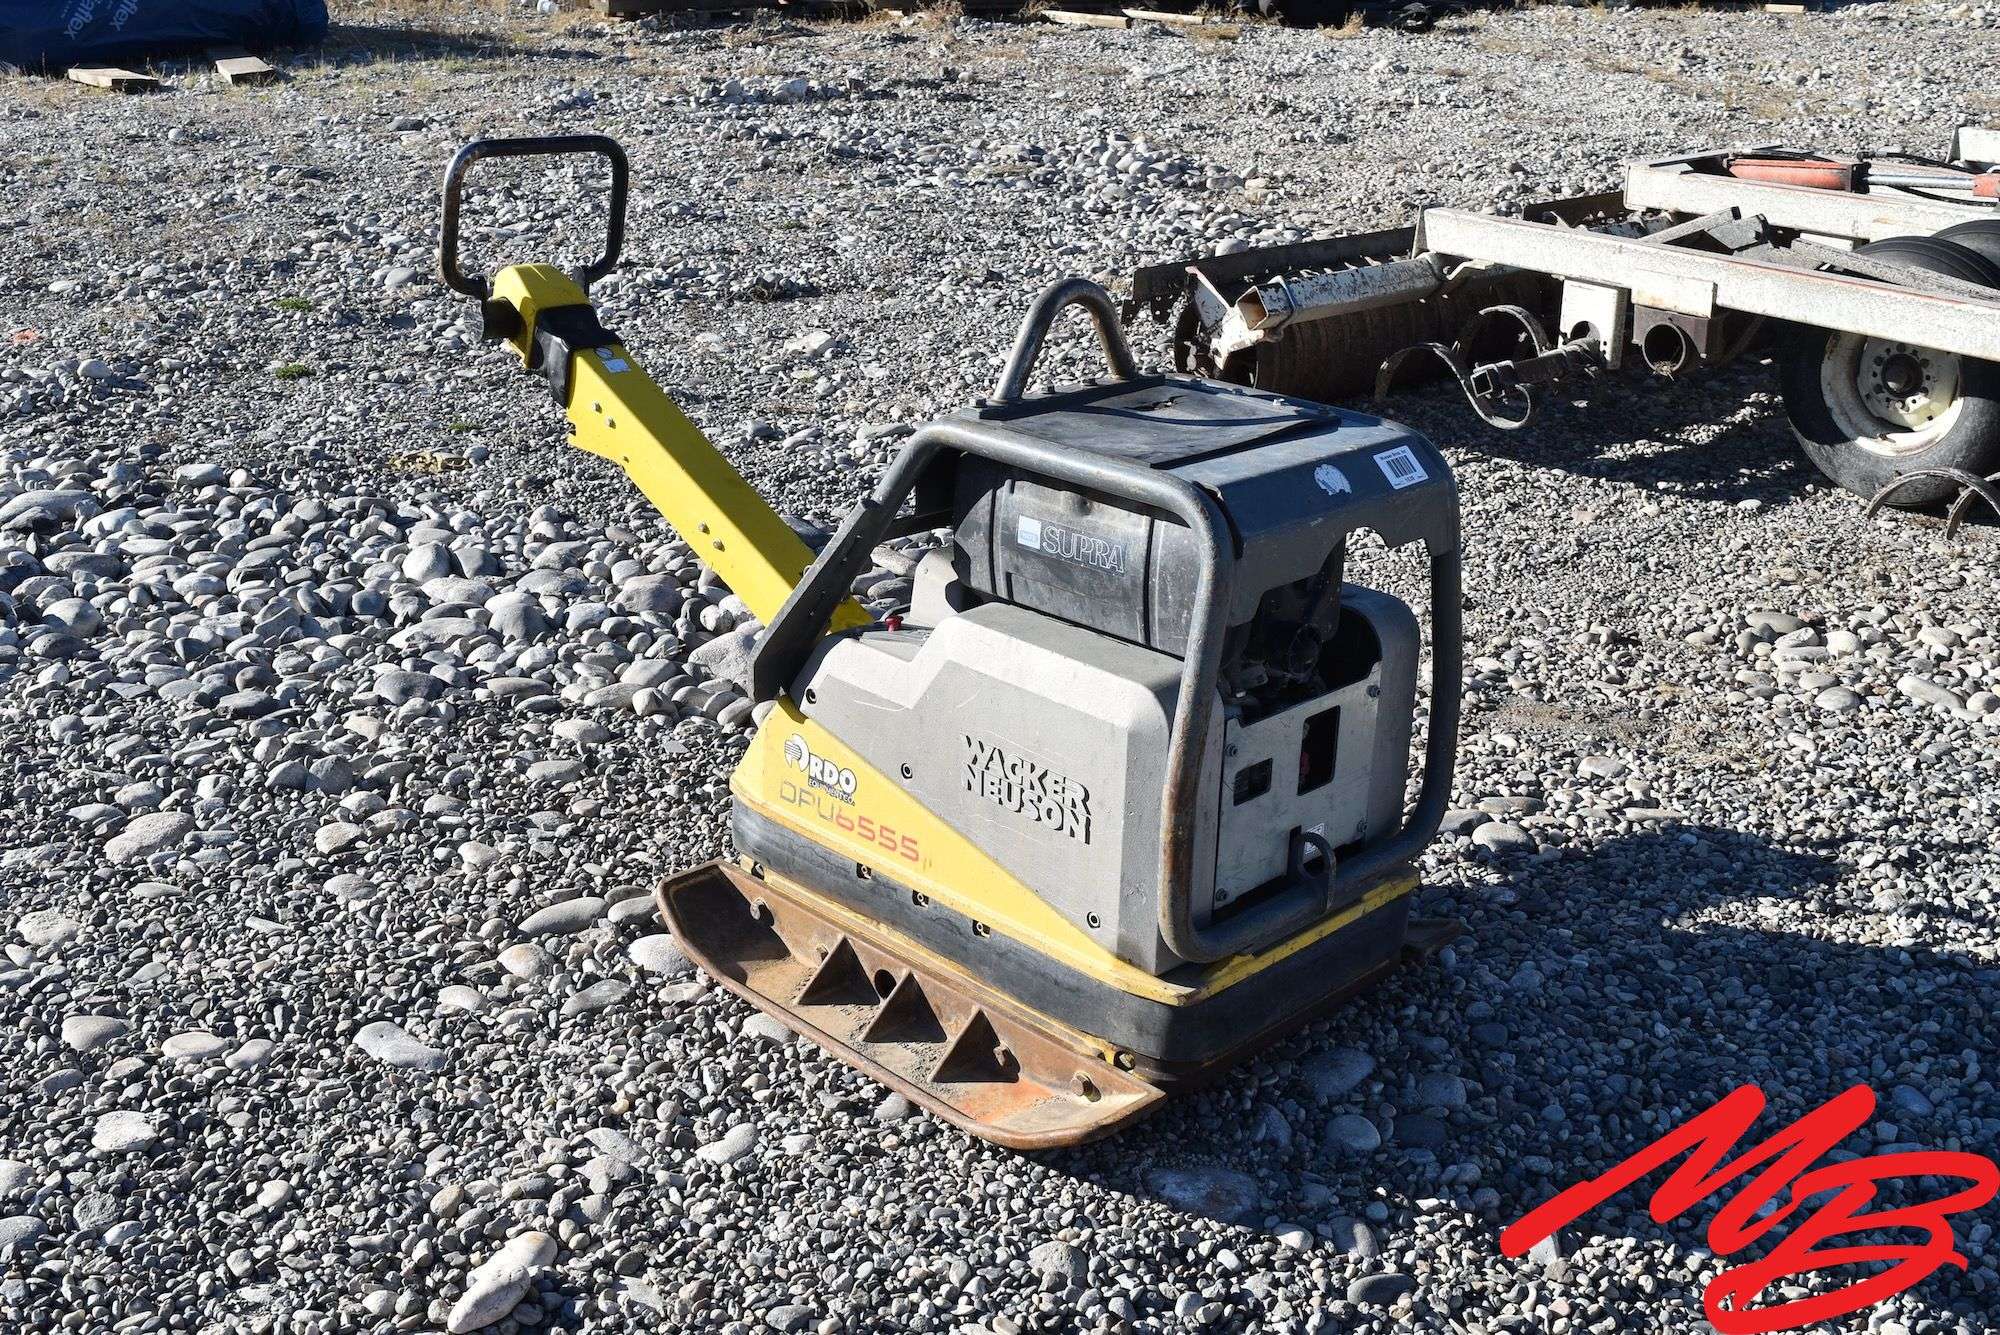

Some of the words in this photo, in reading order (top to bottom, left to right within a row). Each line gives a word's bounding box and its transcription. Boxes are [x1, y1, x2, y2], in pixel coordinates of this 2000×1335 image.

[1042, 524, 1125, 574] SUPRA
[960, 731, 1092, 817] WACKER
[961, 762, 1092, 845] NEUSON
